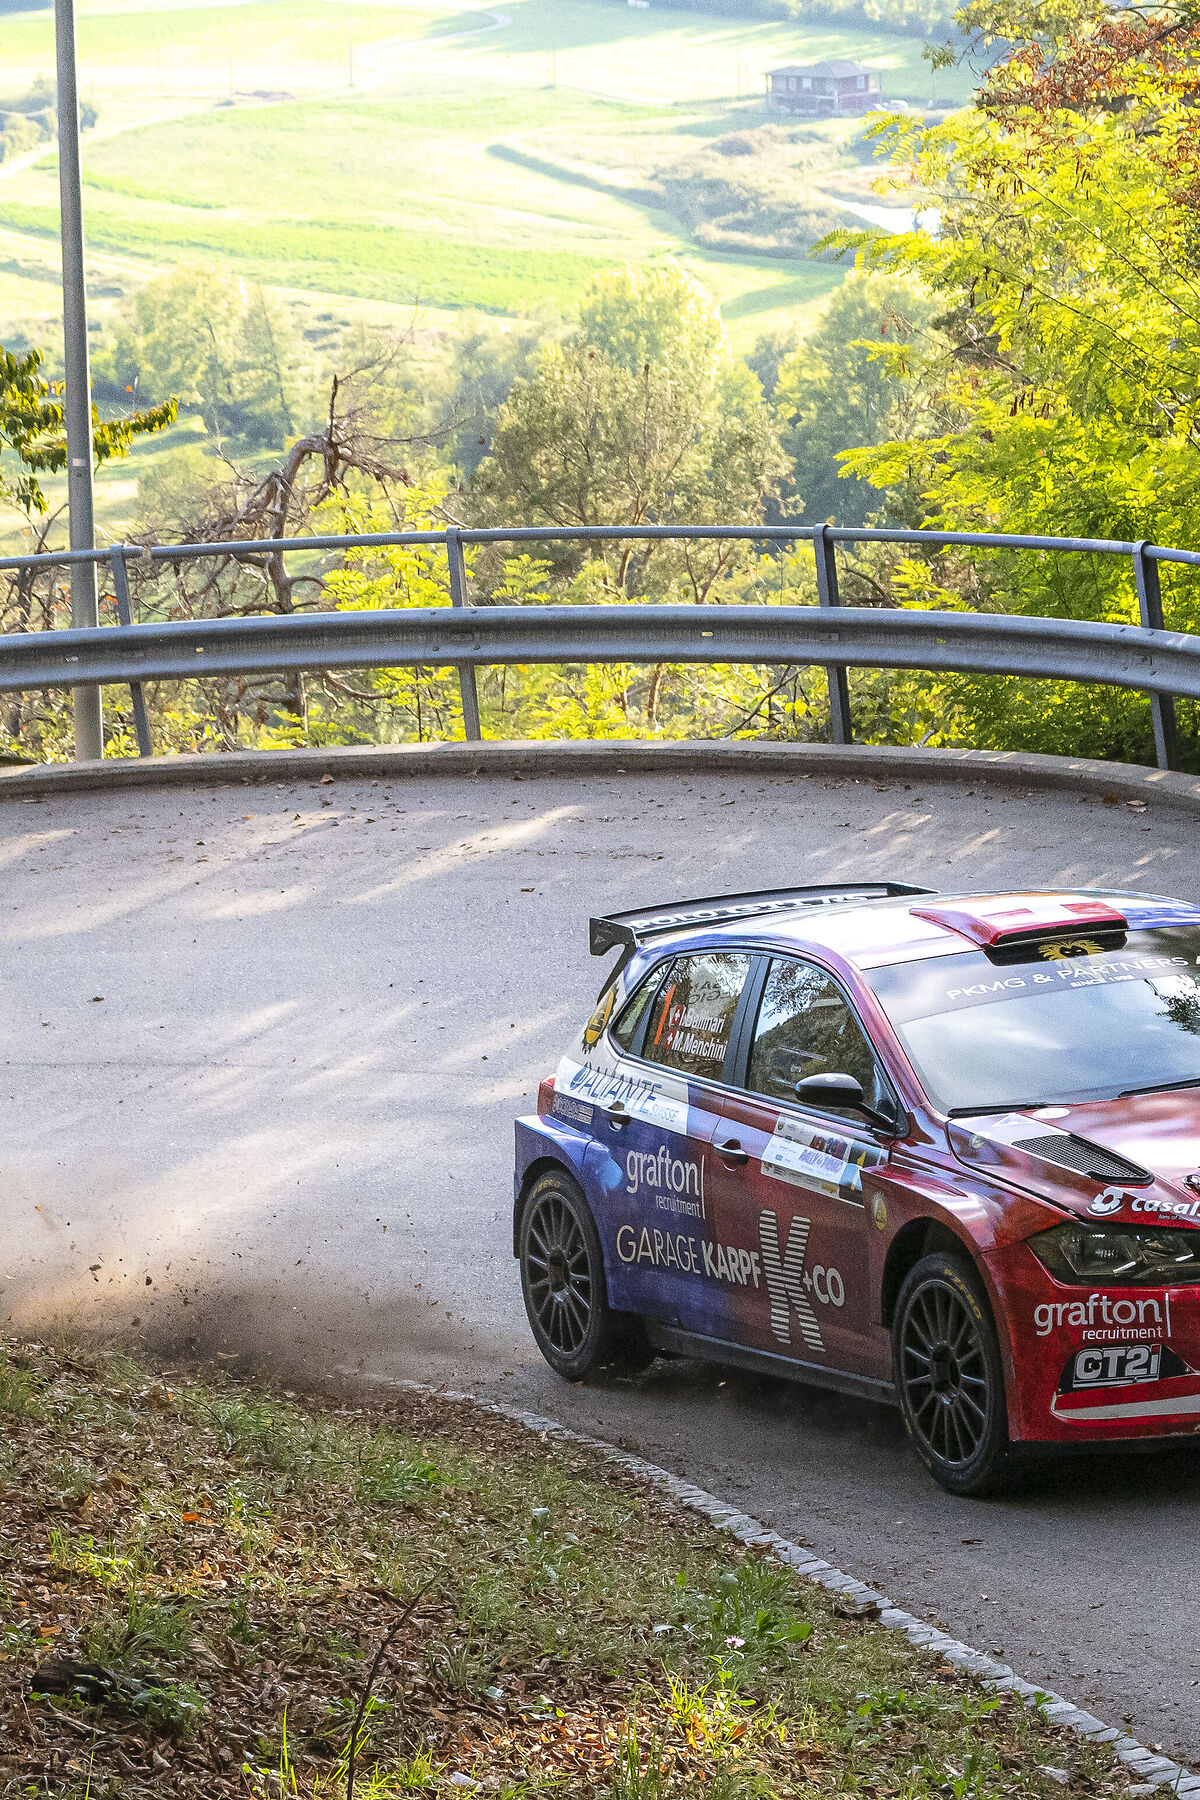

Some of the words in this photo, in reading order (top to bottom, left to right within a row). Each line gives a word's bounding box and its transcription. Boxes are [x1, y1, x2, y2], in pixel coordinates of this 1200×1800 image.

[630, 909, 719, 929] POLO
[946, 975, 1027, 1000] PKMG
[1032, 970, 1055, 984] &
[1057, 955, 1189, 979] PARTNERS
[672, 1031, 728, 1062] M.Menchini
[626, 1145, 700, 1196] grafton
[655, 1194, 701, 1218] recruitment
[616, 1225, 701, 1274] GARAGE
[701, 1240, 762, 1288] KARPF
[1034, 1294, 1162, 1336] grafton
[1082, 1326, 1163, 1340] recruitment
